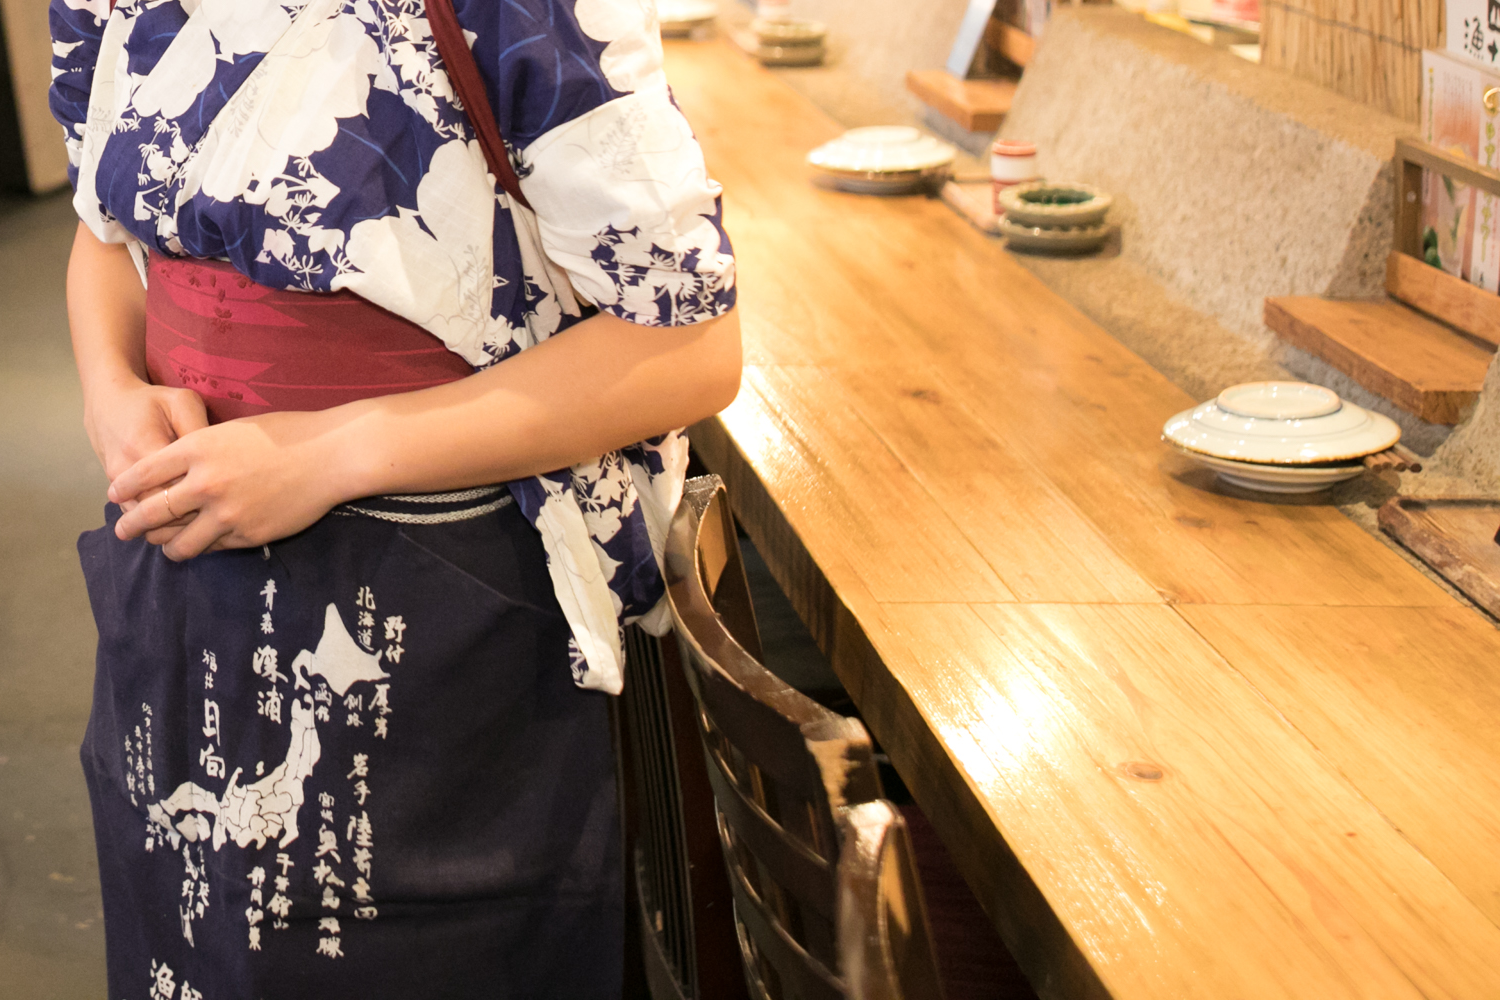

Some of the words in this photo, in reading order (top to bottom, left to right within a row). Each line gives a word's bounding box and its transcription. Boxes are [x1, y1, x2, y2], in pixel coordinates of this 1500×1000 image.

[356, 586, 376, 651] 北海道
[384, 615, 407, 664] 野付
[344, 694, 363, 727] 釧路
[368, 684, 392, 740] 厚岸
